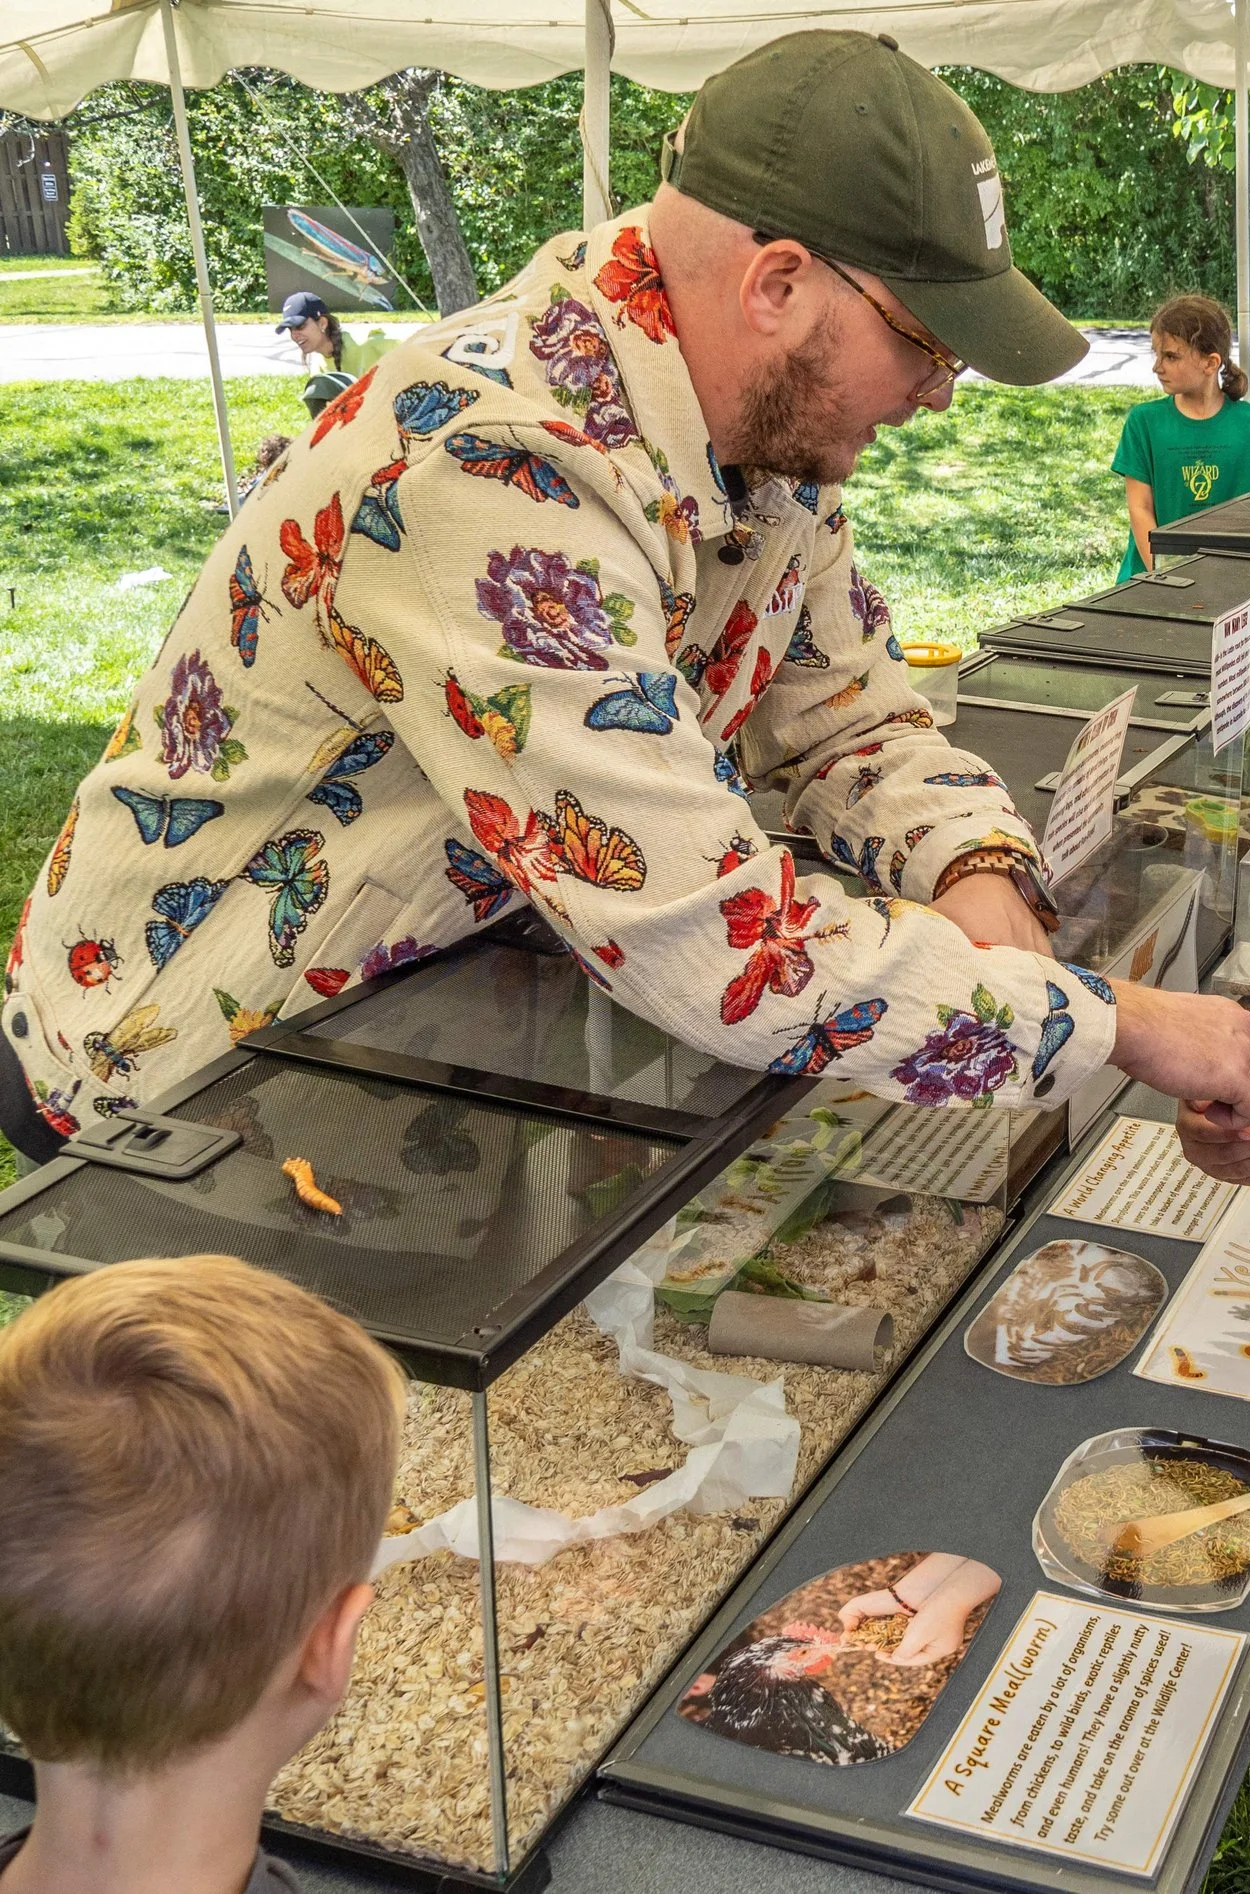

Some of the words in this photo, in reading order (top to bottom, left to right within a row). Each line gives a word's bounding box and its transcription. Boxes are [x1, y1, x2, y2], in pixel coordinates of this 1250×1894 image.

[1182, 465, 1219, 481] WIZARD
[1112, 1122, 1141, 1152] Appetite
[1086, 1152, 1125, 1186] Changing
[1094, 1194, 1118, 1220] Mealworms
[1115, 1187, 1124, 1196] are
[1120, 1180, 1129, 1188] the
[1126, 1169, 1138, 1180] only
[1133, 1154, 1147, 1170] animal
[1142, 1141, 1156, 1155] known
[1129, 1190, 1140, 1200] This
[1138, 1177, 1150, 1190] waste
[1146, 1160, 1161, 1178] product
[1069, 1184, 1096, 1209] World
[1146, 1181, 1166, 1206] decompose
[1158, 1197, 1174, 1212] bucket
[1174, 1167, 1194, 1192] mealworms
[1171, 1209, 1185, 1225] munch
[1181, 1190, 1198, 1210] through!
[1192, 1180, 1204, 1190] This
[1064, 1208, 1076, 1216] A
[1183, 1218, 1199, 1236] changer
[1194, 1210, 1204, 1218] for
[1200, 1182, 1221, 1210] overcrowded
[1069, 1615, 1102, 1664] organisms,
[1154, 1630, 1172, 1657] used!
[1062, 1663, 1076, 1676] of
[1140, 1658, 1159, 1687] spices
[1169, 1642, 1193, 1679] Center!
[1050, 1690, 1060, 1699] a
[1052, 1677, 1068, 1690] lot
[1134, 1686, 1148, 1698] of
[944, 1779, 964, 1796] A
[954, 1718, 1001, 1776] Square
[989, 1618, 1058, 1714] Meal(worm)
[1040, 1700, 1058, 1712] by
[1151, 1679, 1177, 1717] Wildlife
[1010, 1800, 1034, 1828] from
[1026, 1753, 1059, 1799] chickens,
[1050, 1739, 1064, 1751] to
[1058, 1715, 1075, 1738] wild
[1067, 1689, 1092, 1715] birds,
[1084, 1659, 1104, 1688] exotic
[1099, 1623, 1122, 1659] reptiles
[1028, 1713, 1049, 1743] eaten
[1119, 1699, 1140, 1732] aroma
[1144, 1718, 1160, 1736] the
[1037, 1816, 1054, 1838] and
[1049, 1790, 1068, 1817] even
[1059, 1743, 1091, 1790] humans!
[1081, 1718, 1105, 1742] They
[1094, 1693, 1115, 1718] have
[1112, 1650, 1138, 1685] slightly
[1130, 1623, 1150, 1649] nutty
[1109, 1732, 1124, 1750] the
[1140, 1736, 1152, 1748] at
[1018, 1743, 1033, 1761] are
[1103, 1751, 1116, 1766] on
[1129, 1748, 1146, 1773] over
[1090, 1767, 1109, 1790] take
[1120, 1773, 1136, 1793] out
[981, 1762, 1023, 1824] Mealworms
[1081, 1790, 1097, 1813] and
[1106, 1794, 1126, 1824] some
[1064, 1816, 1089, 1844] taste,
[1094, 1824, 1114, 1842] Try
